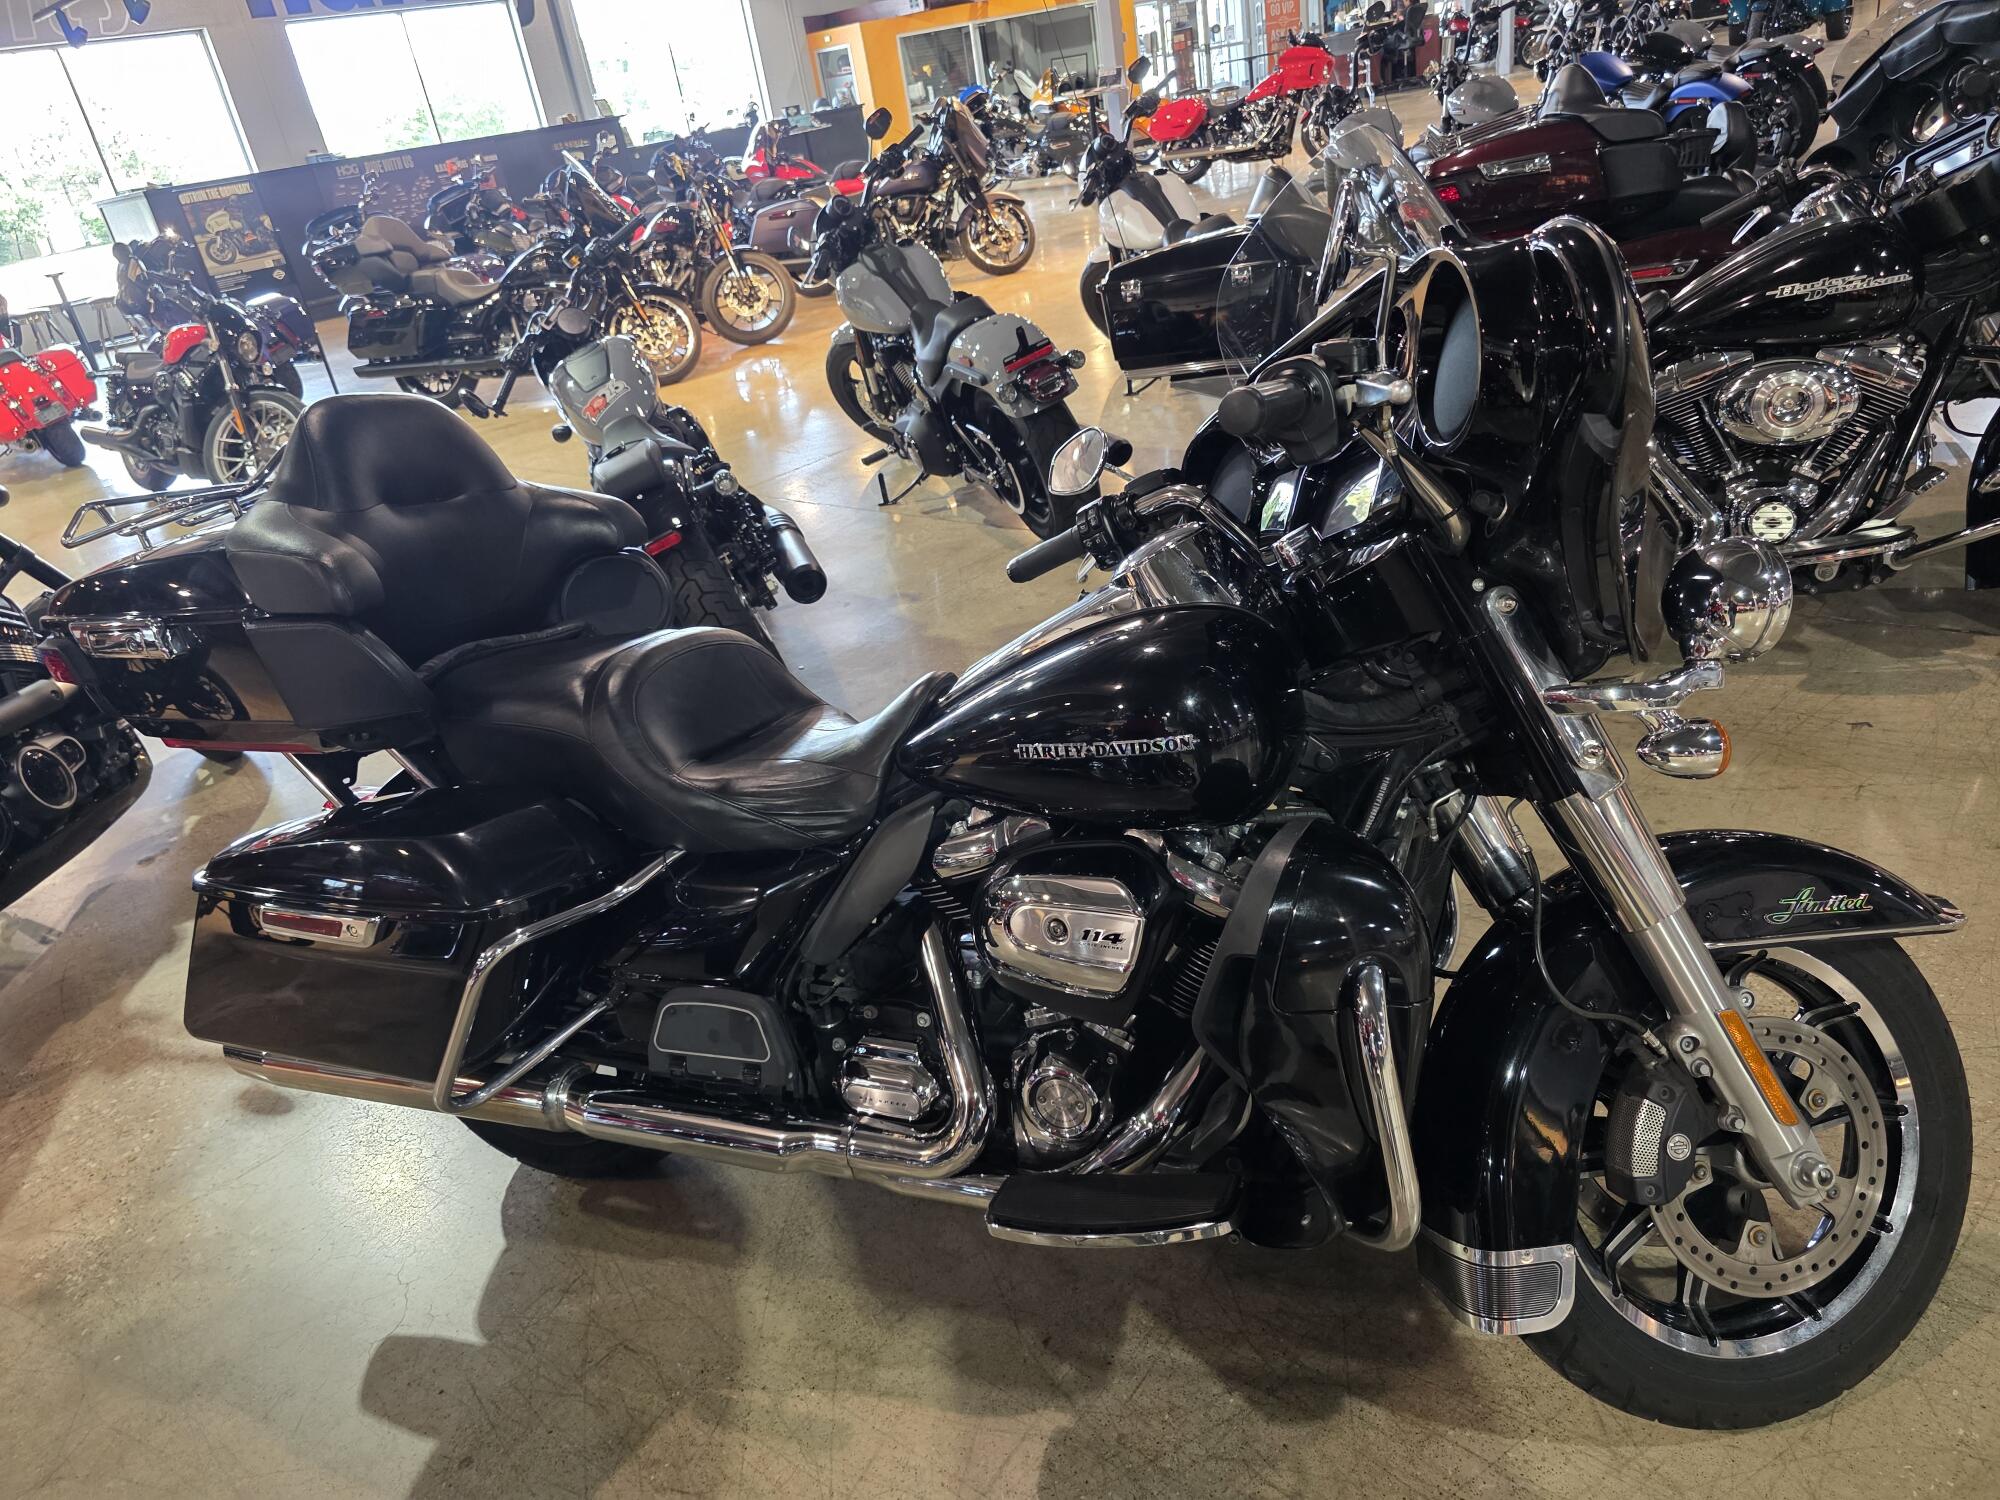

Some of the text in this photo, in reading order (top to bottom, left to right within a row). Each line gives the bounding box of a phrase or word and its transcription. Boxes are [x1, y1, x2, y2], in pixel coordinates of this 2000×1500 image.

[1270, 1, 1295, 16] GO VIP.
[384, 156, 402, 172] WITH
[403, 154, 414, 169] US
[1766, 275, 1867, 298] Harley
[1804, 274, 1913, 301] Davidson
[1763, 887, 1874, 925] Limited
[1081, 929, 1126, 945] 114
